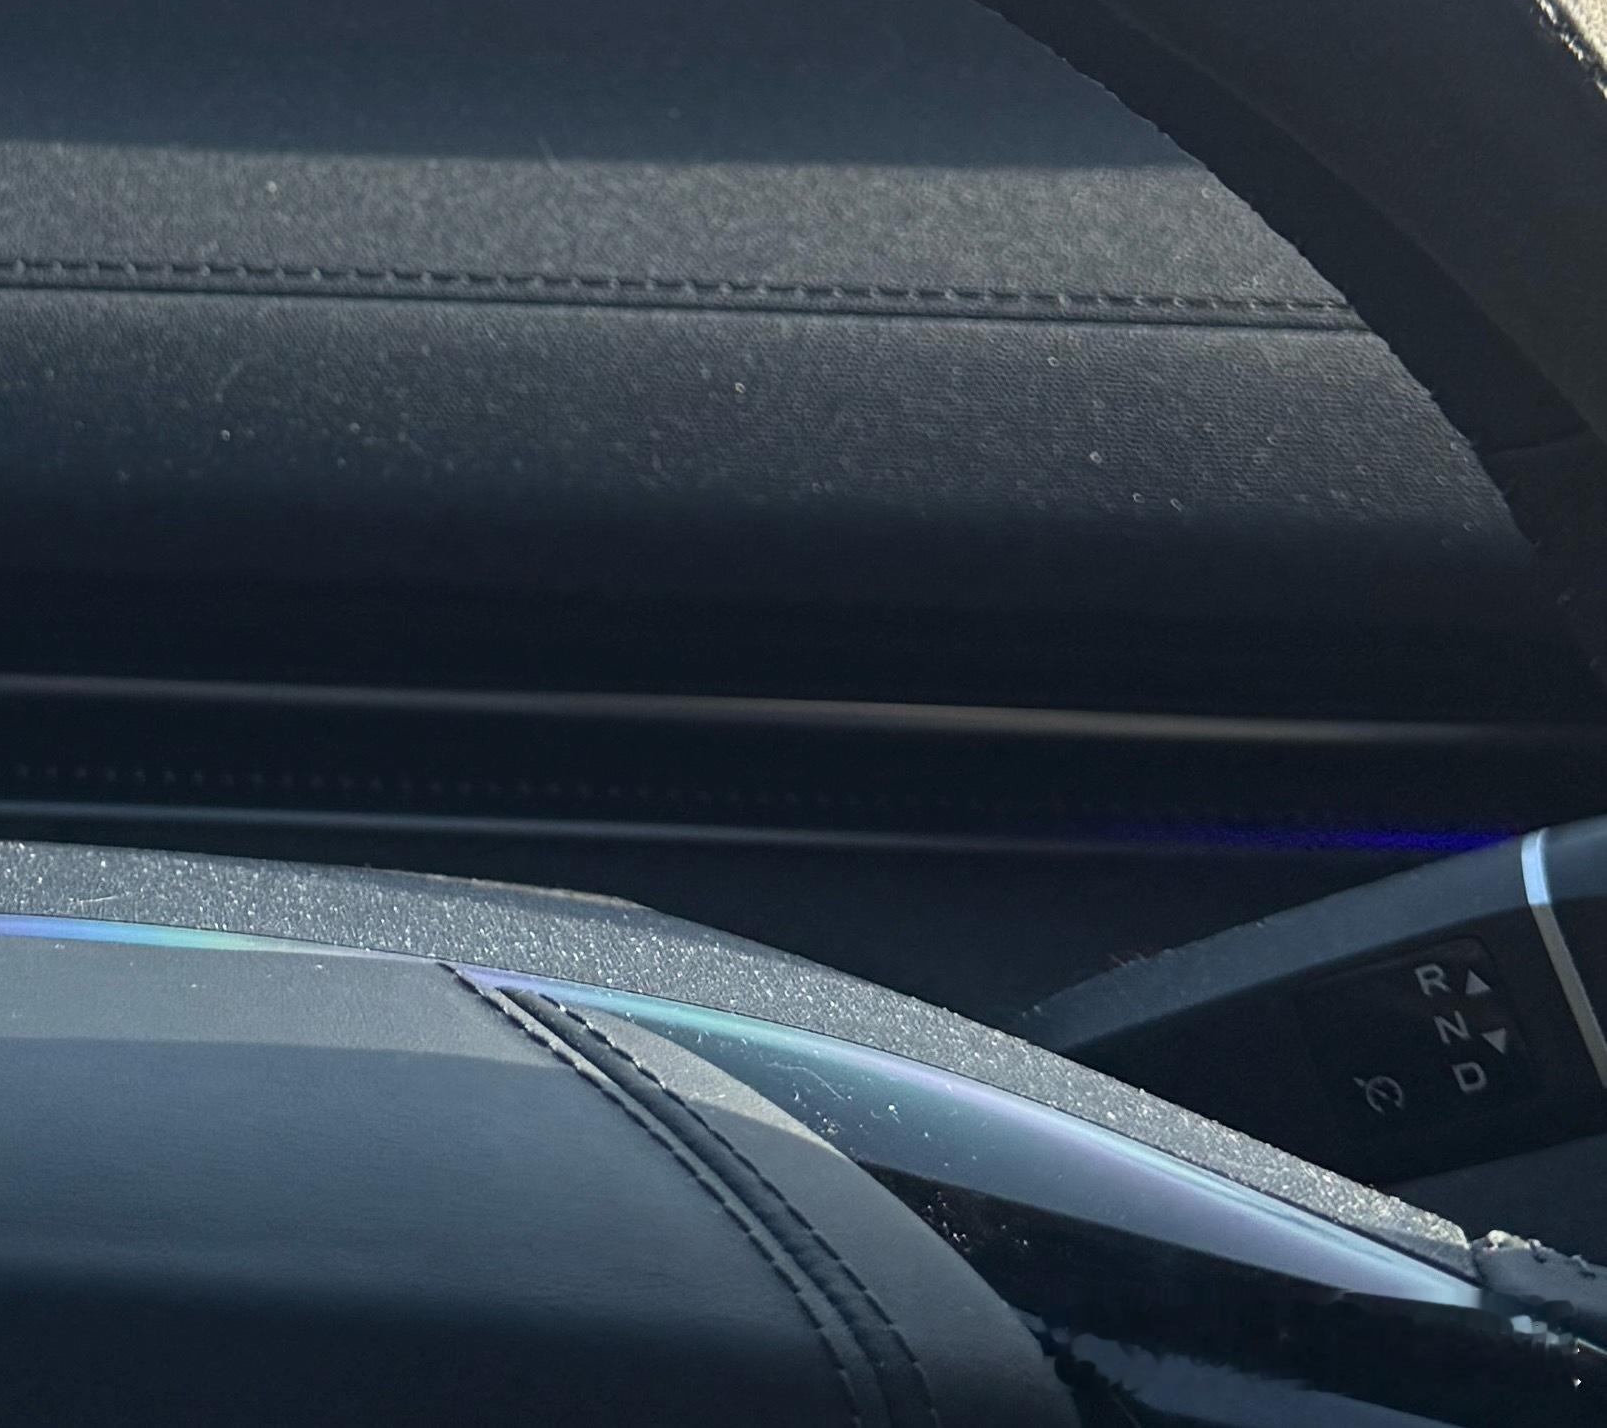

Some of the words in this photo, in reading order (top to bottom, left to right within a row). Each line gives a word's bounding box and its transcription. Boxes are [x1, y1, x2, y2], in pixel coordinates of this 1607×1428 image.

[1415, 963, 1452, 997] R
[1433, 1010, 1471, 1045] N
[1452, 1061, 1488, 1093] D
